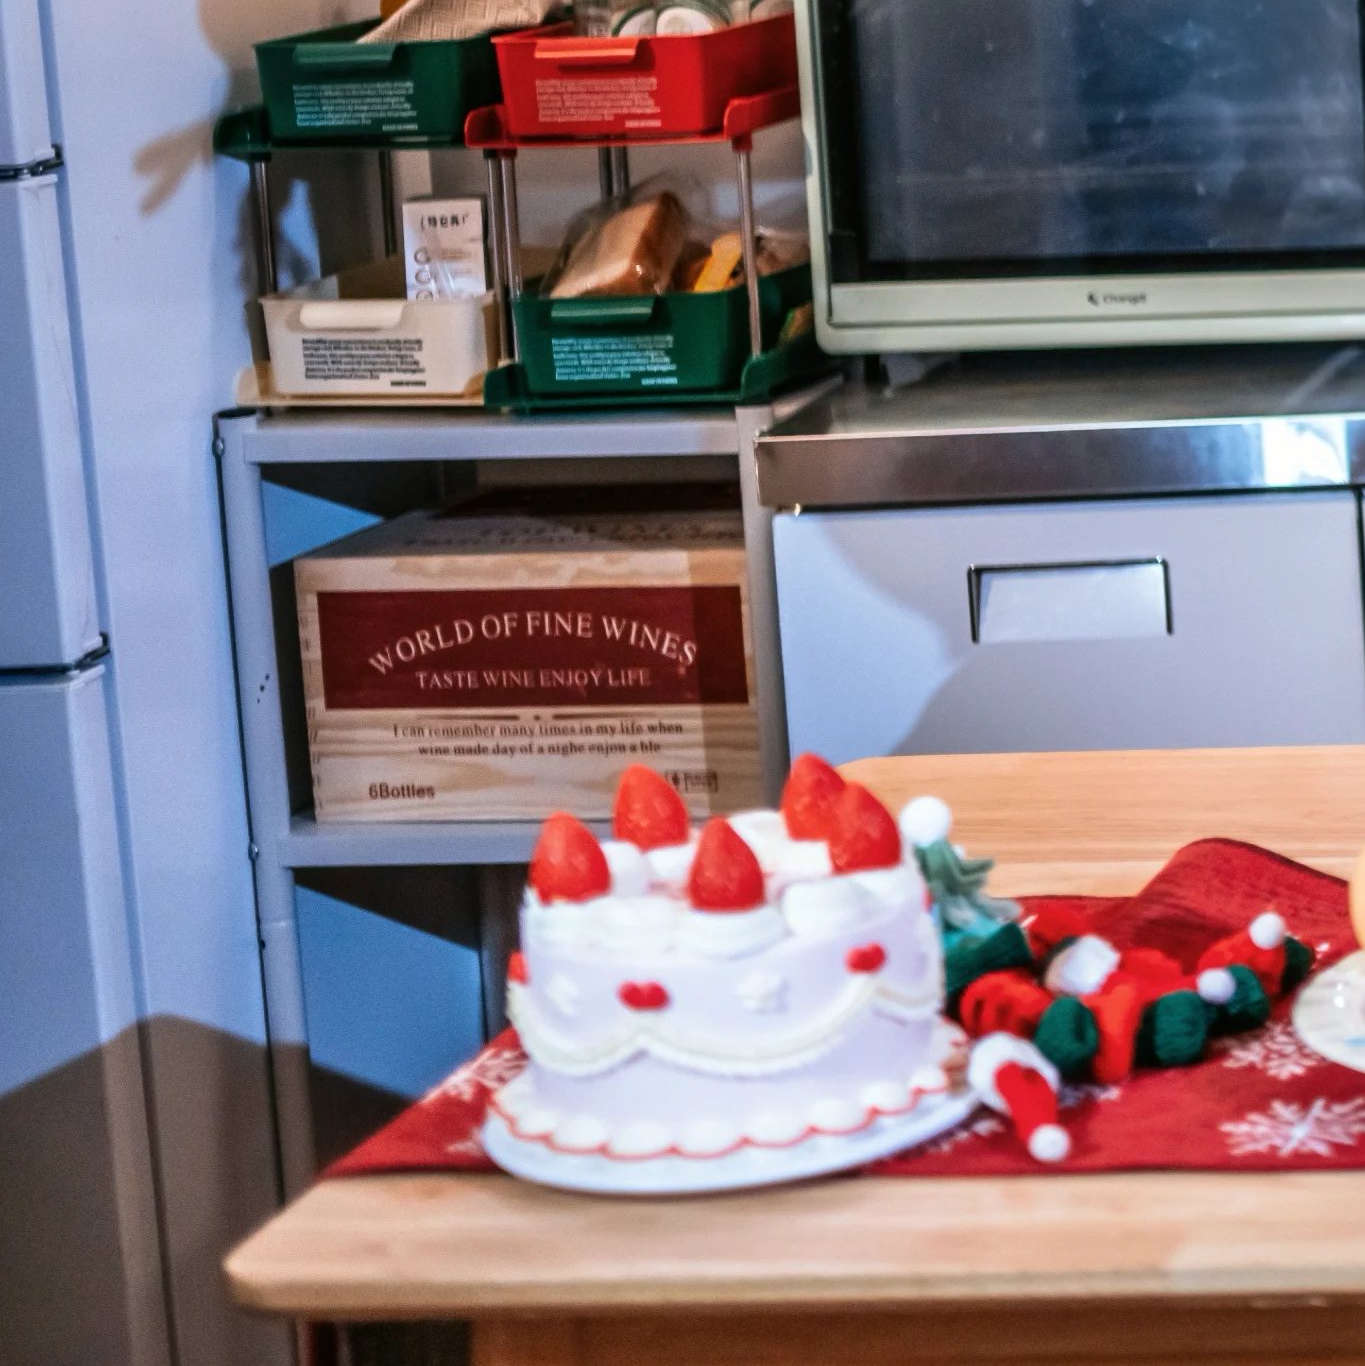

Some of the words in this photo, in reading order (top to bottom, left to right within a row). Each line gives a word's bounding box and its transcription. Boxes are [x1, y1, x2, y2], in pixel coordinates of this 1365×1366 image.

[368, 618, 474, 676] WORLD
[481, 612, 518, 640] OF
[525, 610, 593, 639] FINE
[602, 614, 698, 667] WINES
[415, 670, 479, 690] TASTE
[482, 668, 537, 688] WINE
[540, 668, 602, 688] ENJOY
[607, 668, 652, 687] LIFE
[428, 723, 496, 738] remember
[499, 725, 535, 740] many
[539, 723, 576, 736] times
[579, 723, 592, 736] in
[596, 724, 617, 738] my
[620, 720, 643, 735] life
[646, 720, 684, 734] when
[418, 745, 450, 756] wine
[453, 743, 489, 755] made
[368, 781, 436, 801] 6Bottles
